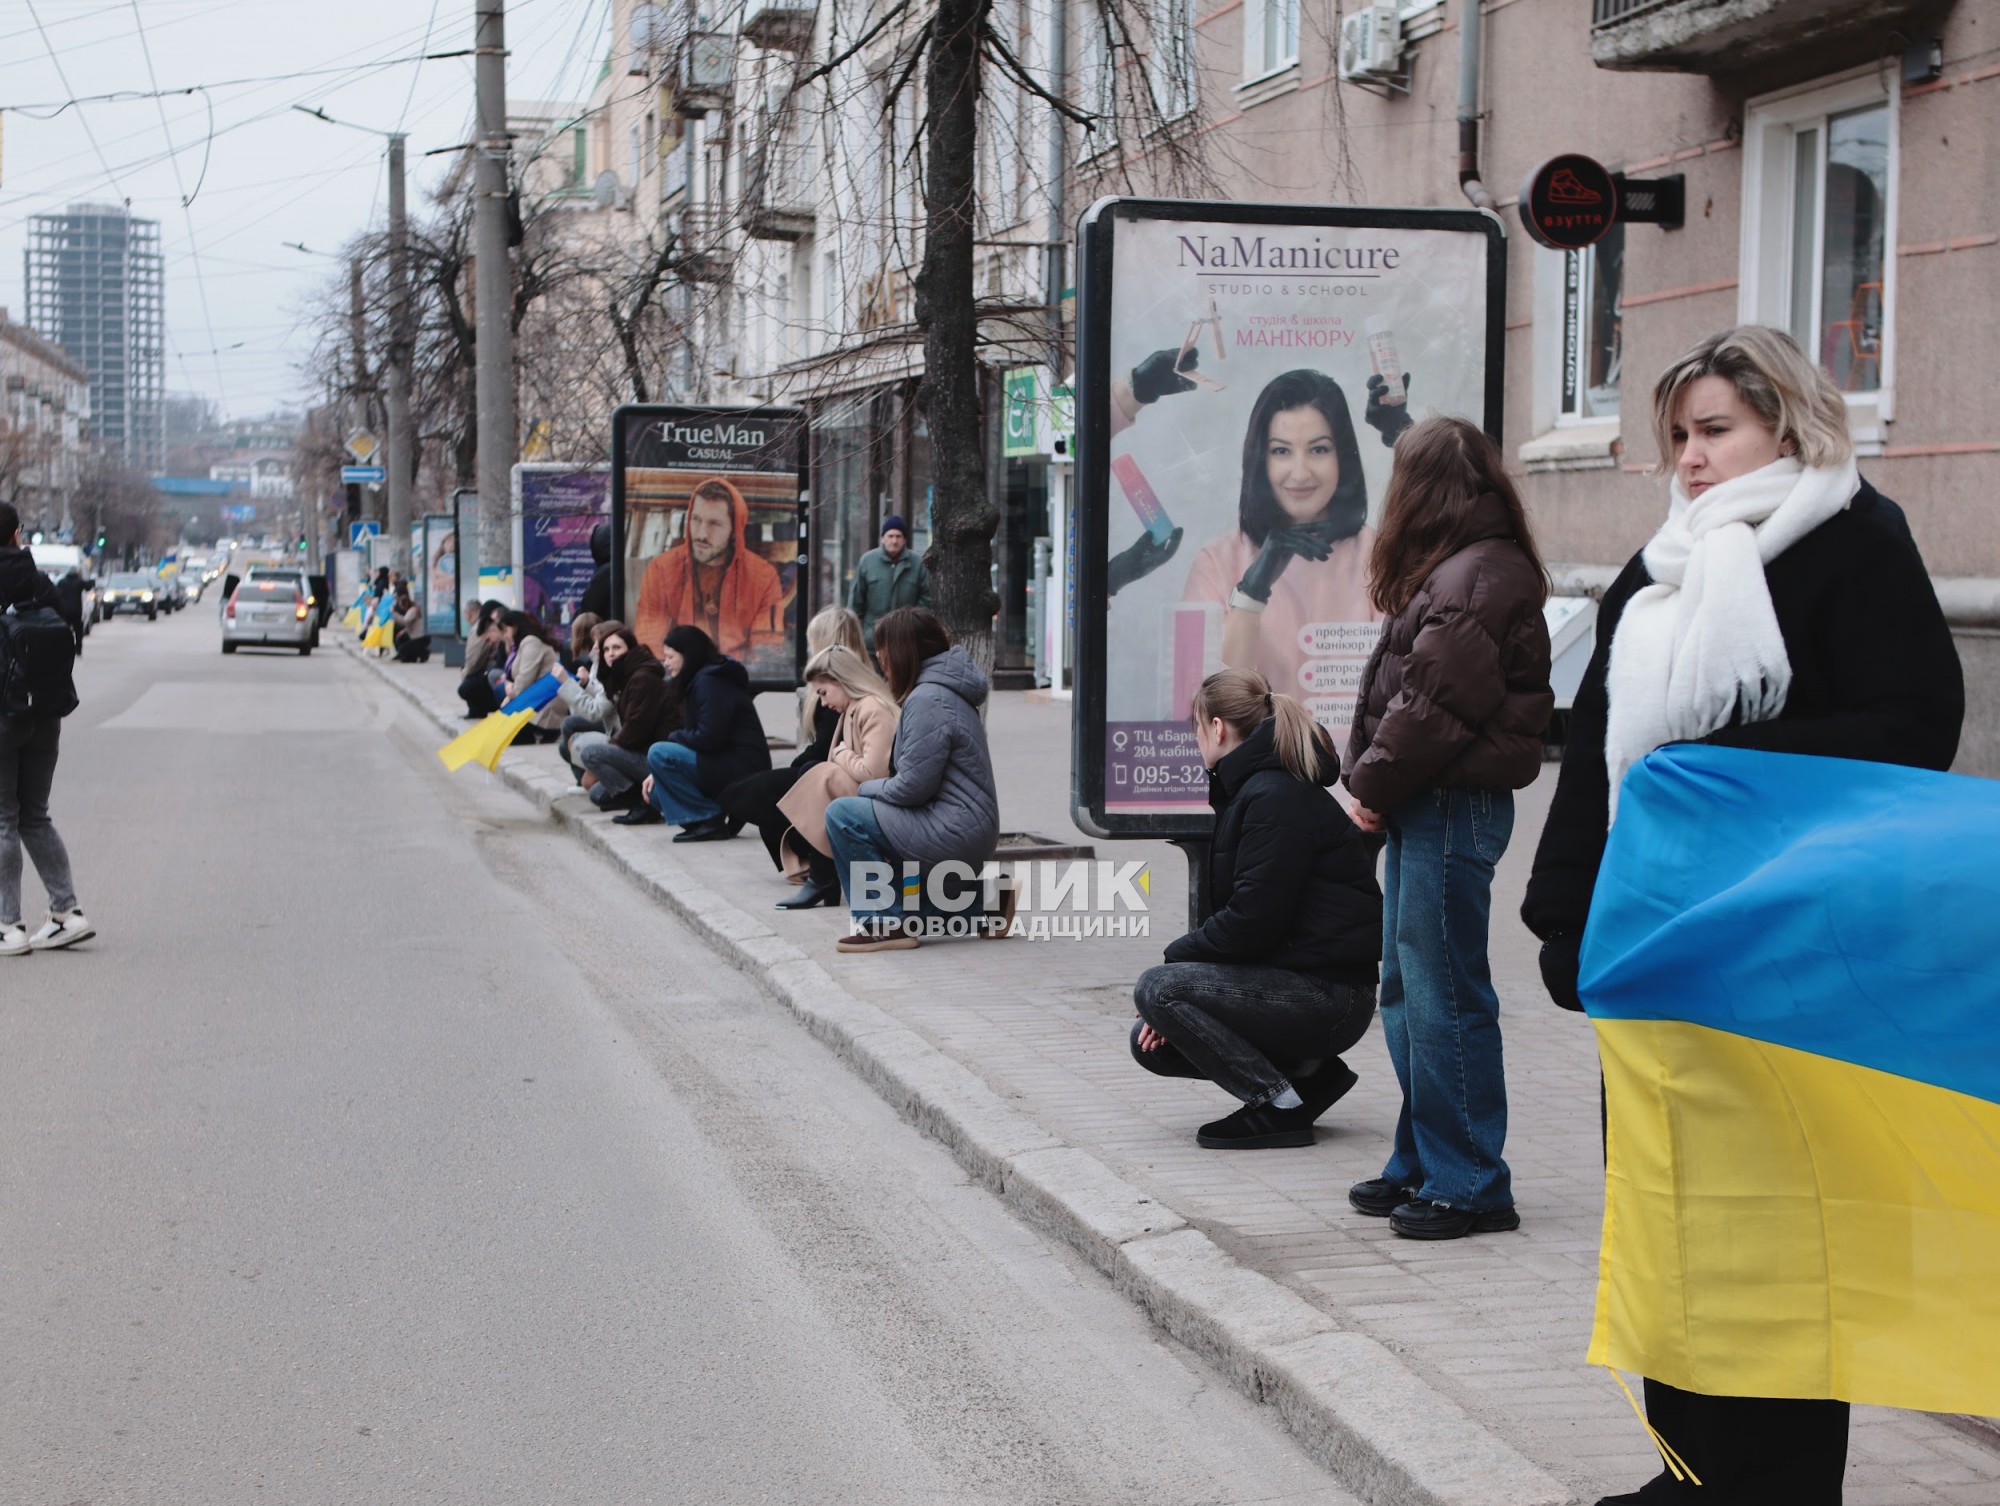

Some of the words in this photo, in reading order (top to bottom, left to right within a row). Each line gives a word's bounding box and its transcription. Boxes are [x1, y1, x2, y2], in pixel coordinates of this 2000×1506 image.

[1177, 236, 1400, 269] NaManicure
[1208, 284, 1273, 295] STUDIO
[1281, 285, 1290, 296] &
[1299, 285, 1368, 296] SCHOOL
[1249, 314, 1287, 326] студія
[1290, 315, 1299, 325] &
[1303, 316, 1342, 326] школа
[1236, 329, 1356, 347] МАНІКЮРУ
[657, 421, 765, 446] TrueMan
[687, 448, 734, 460] CASUAL
[1315, 639, 1365, 652] манікюр
[1315, 678, 1336, 687] для
[1133, 730, 1153, 743] ТЦ
[1134, 746, 1156, 758] 204
[1133, 765, 1210, 784] 095-32
